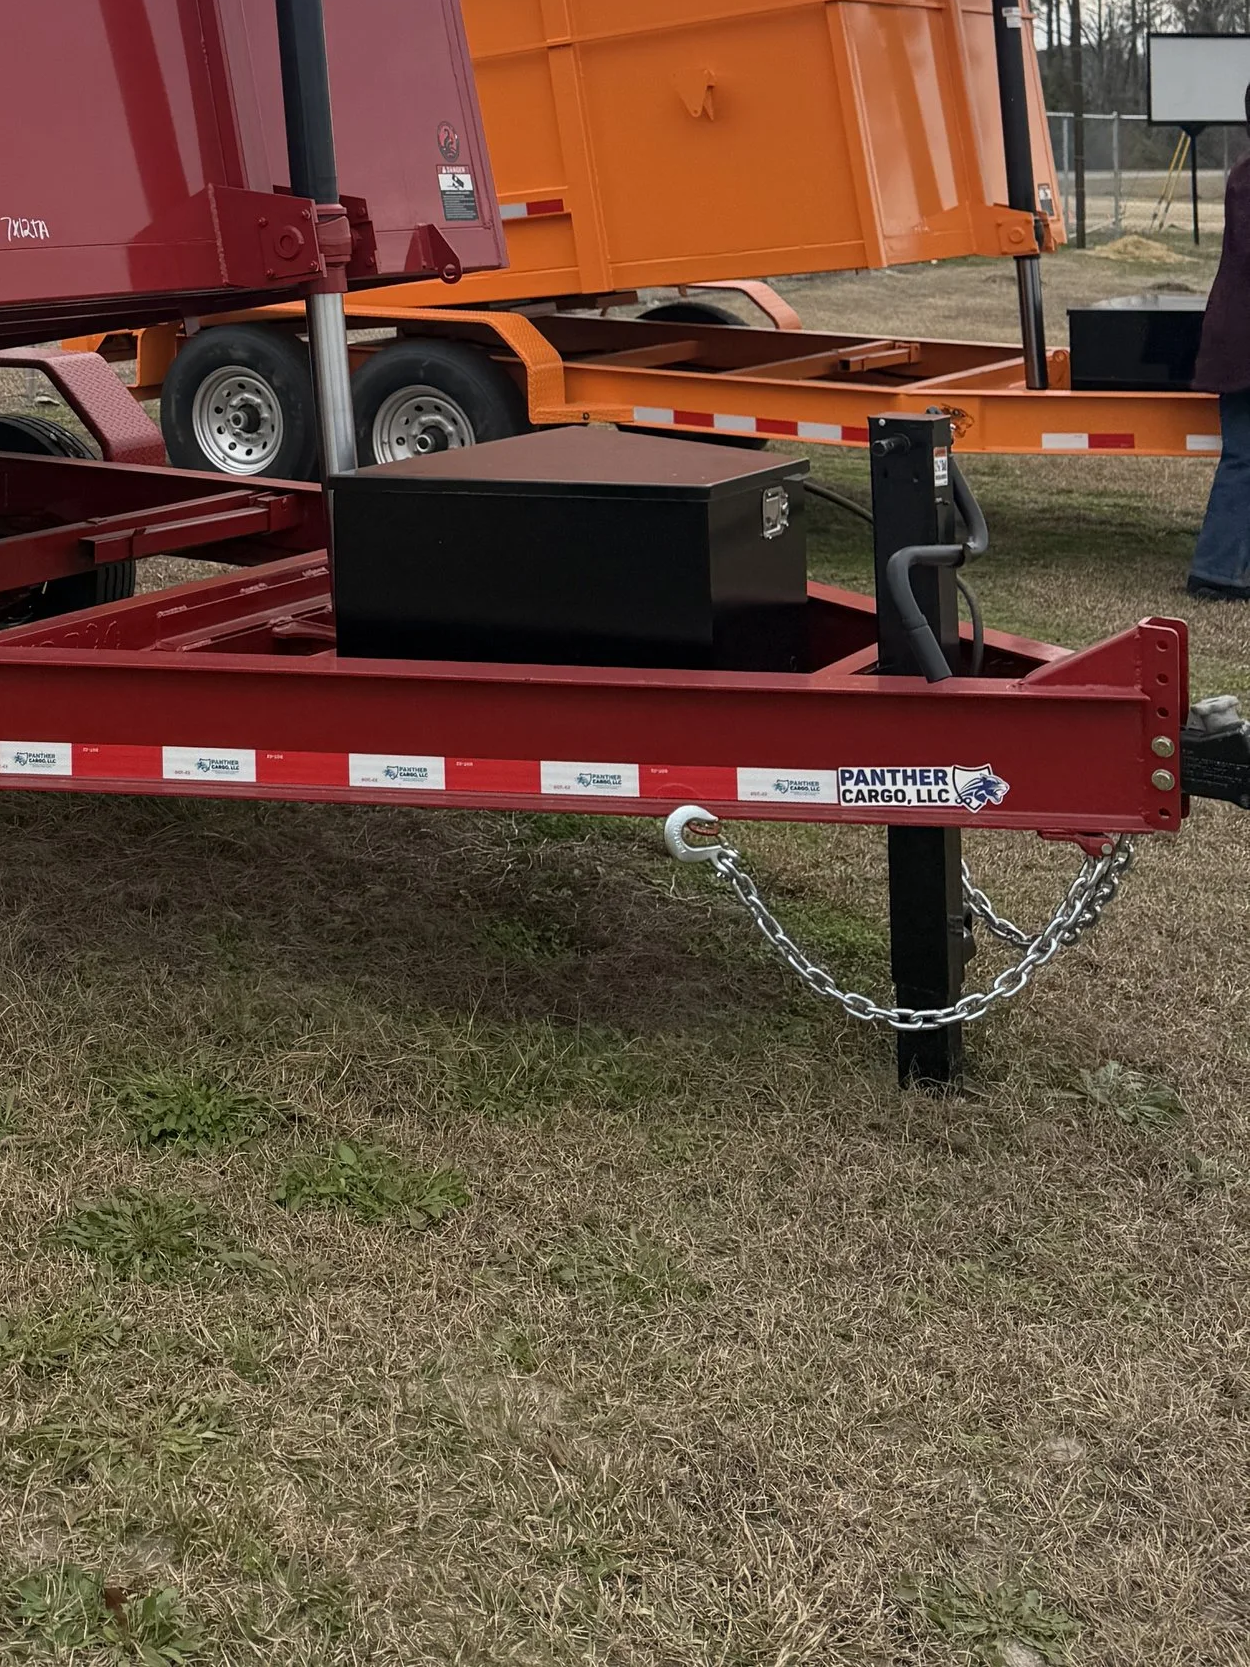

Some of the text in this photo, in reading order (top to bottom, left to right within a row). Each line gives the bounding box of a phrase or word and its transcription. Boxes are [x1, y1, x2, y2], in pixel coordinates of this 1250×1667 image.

[840, 769, 948, 787] PANTHER
[842, 788, 950, 805] CARGO, LLC
